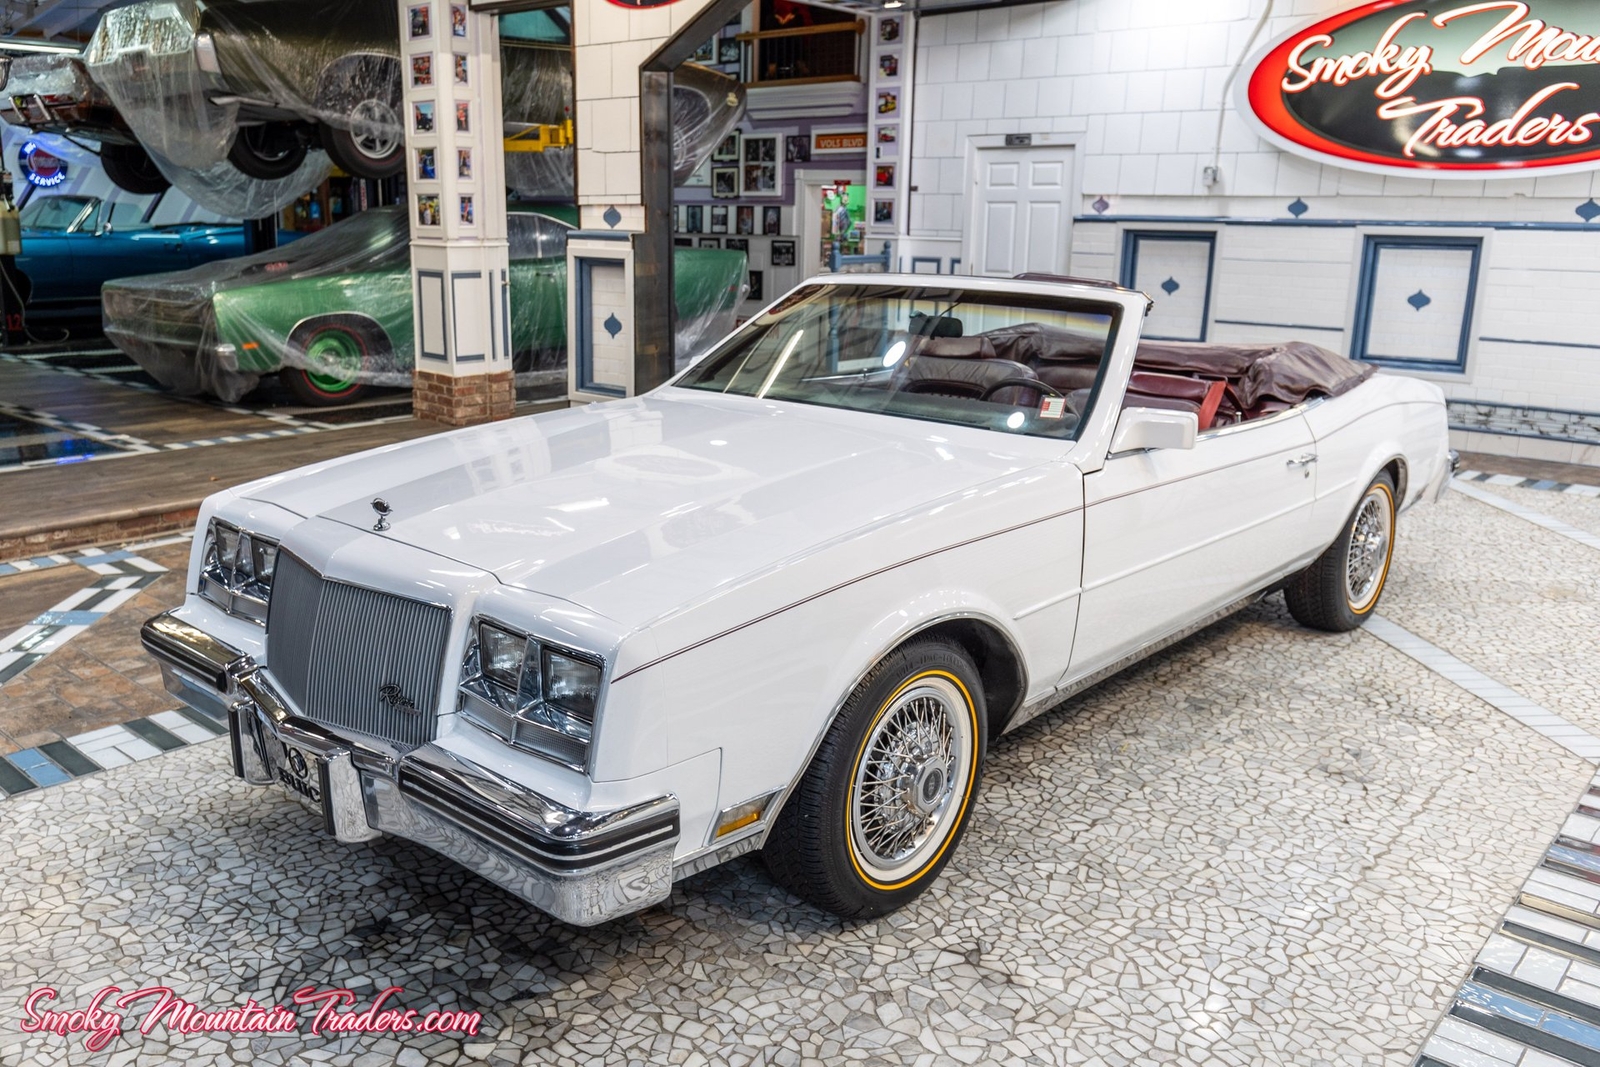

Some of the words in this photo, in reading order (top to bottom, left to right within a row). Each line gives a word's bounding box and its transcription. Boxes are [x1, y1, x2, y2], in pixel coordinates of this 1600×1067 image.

[1281, 12, 1433, 97] Smoky
[1377, 82, 1600, 158] Traders
[820, 138, 840, 148] VOLS
[842, 138, 864, 147] BLVD
[29, 171, 65, 186] SERVICE
